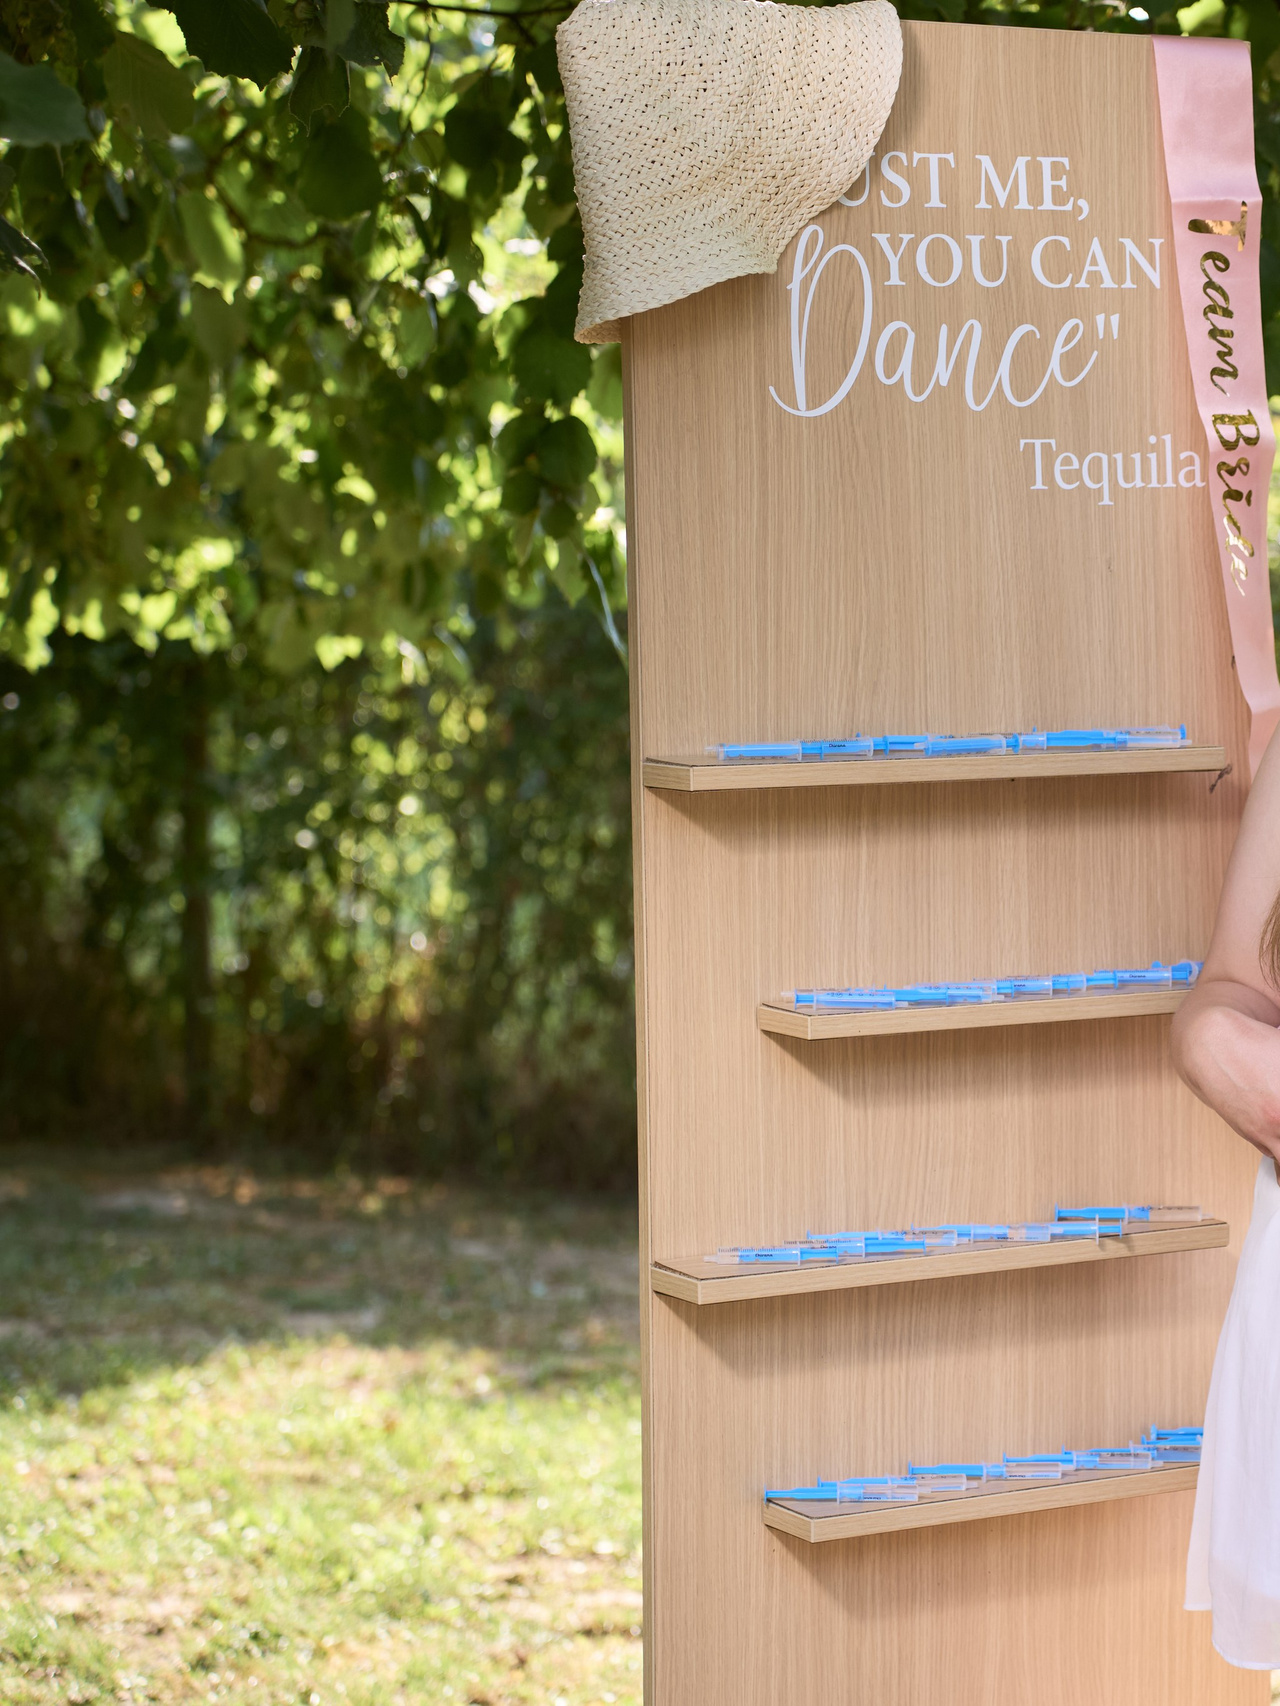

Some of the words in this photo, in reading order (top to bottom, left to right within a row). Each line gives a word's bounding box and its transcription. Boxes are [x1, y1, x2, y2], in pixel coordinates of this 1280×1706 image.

[974, 154, 1090, 220] ME,
[768, 224, 1120, 418] Dance"
[871, 232, 1013, 288] YOU
[1030, 234, 1165, 290] CAN
[1187, 200, 1249, 397] Team
[1019, 434, 1206, 506] Tequila
[1211, 408, 1261, 597] Bride
